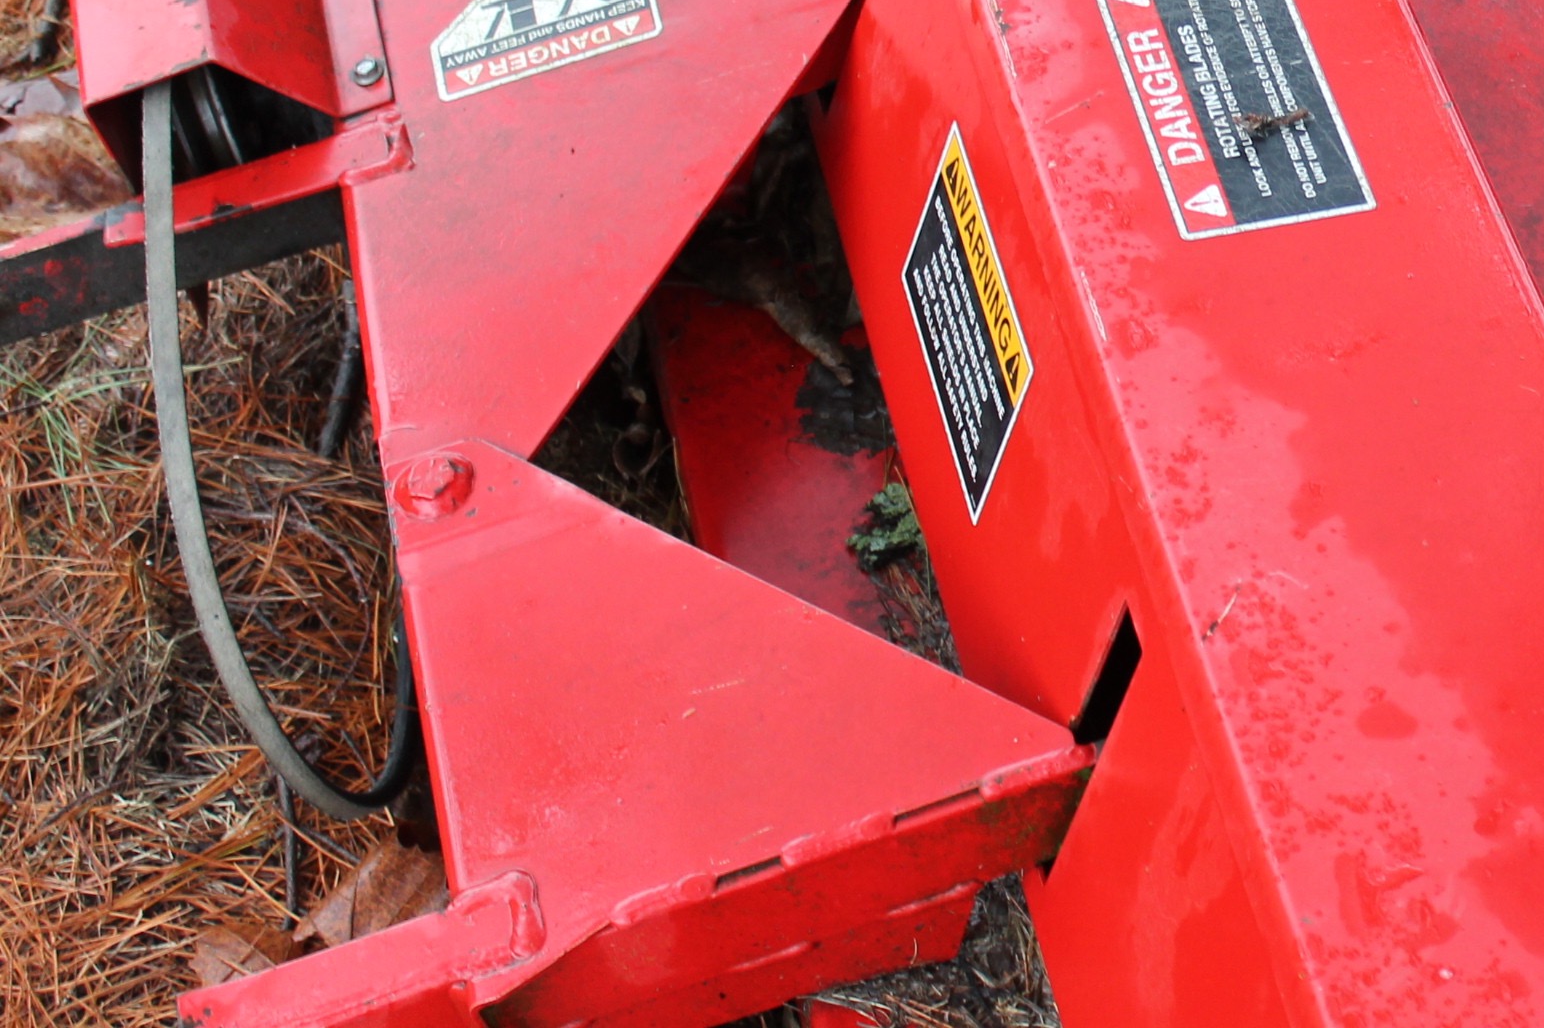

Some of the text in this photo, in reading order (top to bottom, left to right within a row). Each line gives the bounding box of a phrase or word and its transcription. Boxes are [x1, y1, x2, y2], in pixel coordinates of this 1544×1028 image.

[555, 9, 605, 32] HANDS
[1233, 8, 1246, 22] TO
[490, 34, 526, 53] FEET
[527, 25, 553, 41] and
[1199, 31, 1214, 45] OF
[1238, 23, 1263, 63] ATTEMPT
[1254, 22, 1272, 48] HAVE
[446, 46, 487, 67] AWAY
[488, 25, 610, 76] DANGER
[1205, 45, 1231, 91] EVIDENCE
[1255, 64, 1269, 79] OR
[1265, 48, 1297, 111] COMPONENTS
[1127, 29, 1203, 164] DANGER
[1177, 24, 1239, 157] ROTATING BLADES
[1223, 91, 1239, 112] FOR
[1261, 79, 1284, 117] SHIELDS
[1294, 117, 1306, 131] AL
[1244, 145, 1261, 167] AND
[1281, 127, 1301, 160] REMOV
[1298, 131, 1317, 160] UNTIL
[1252, 167, 1272, 196] LOOK
[1292, 161, 1310, 181] NOT
[1308, 160, 1327, 183] UNIT
[1301, 181, 1316, 198] DO
[955, 177, 1011, 354] WARNING
[934, 195, 1005, 420] BEFORE OPERATING THIS MACHINE
[938, 243, 988, 401] READ AND UNDERSTAND
[930, 252, 982, 428] THE OPERATOR'S MANUAL.
[923, 264, 979, 450] KEEP ALL SHIELDS IN PLACE
[912, 267, 977, 482] AND FOLLOW ALL SAFETY RULES.
